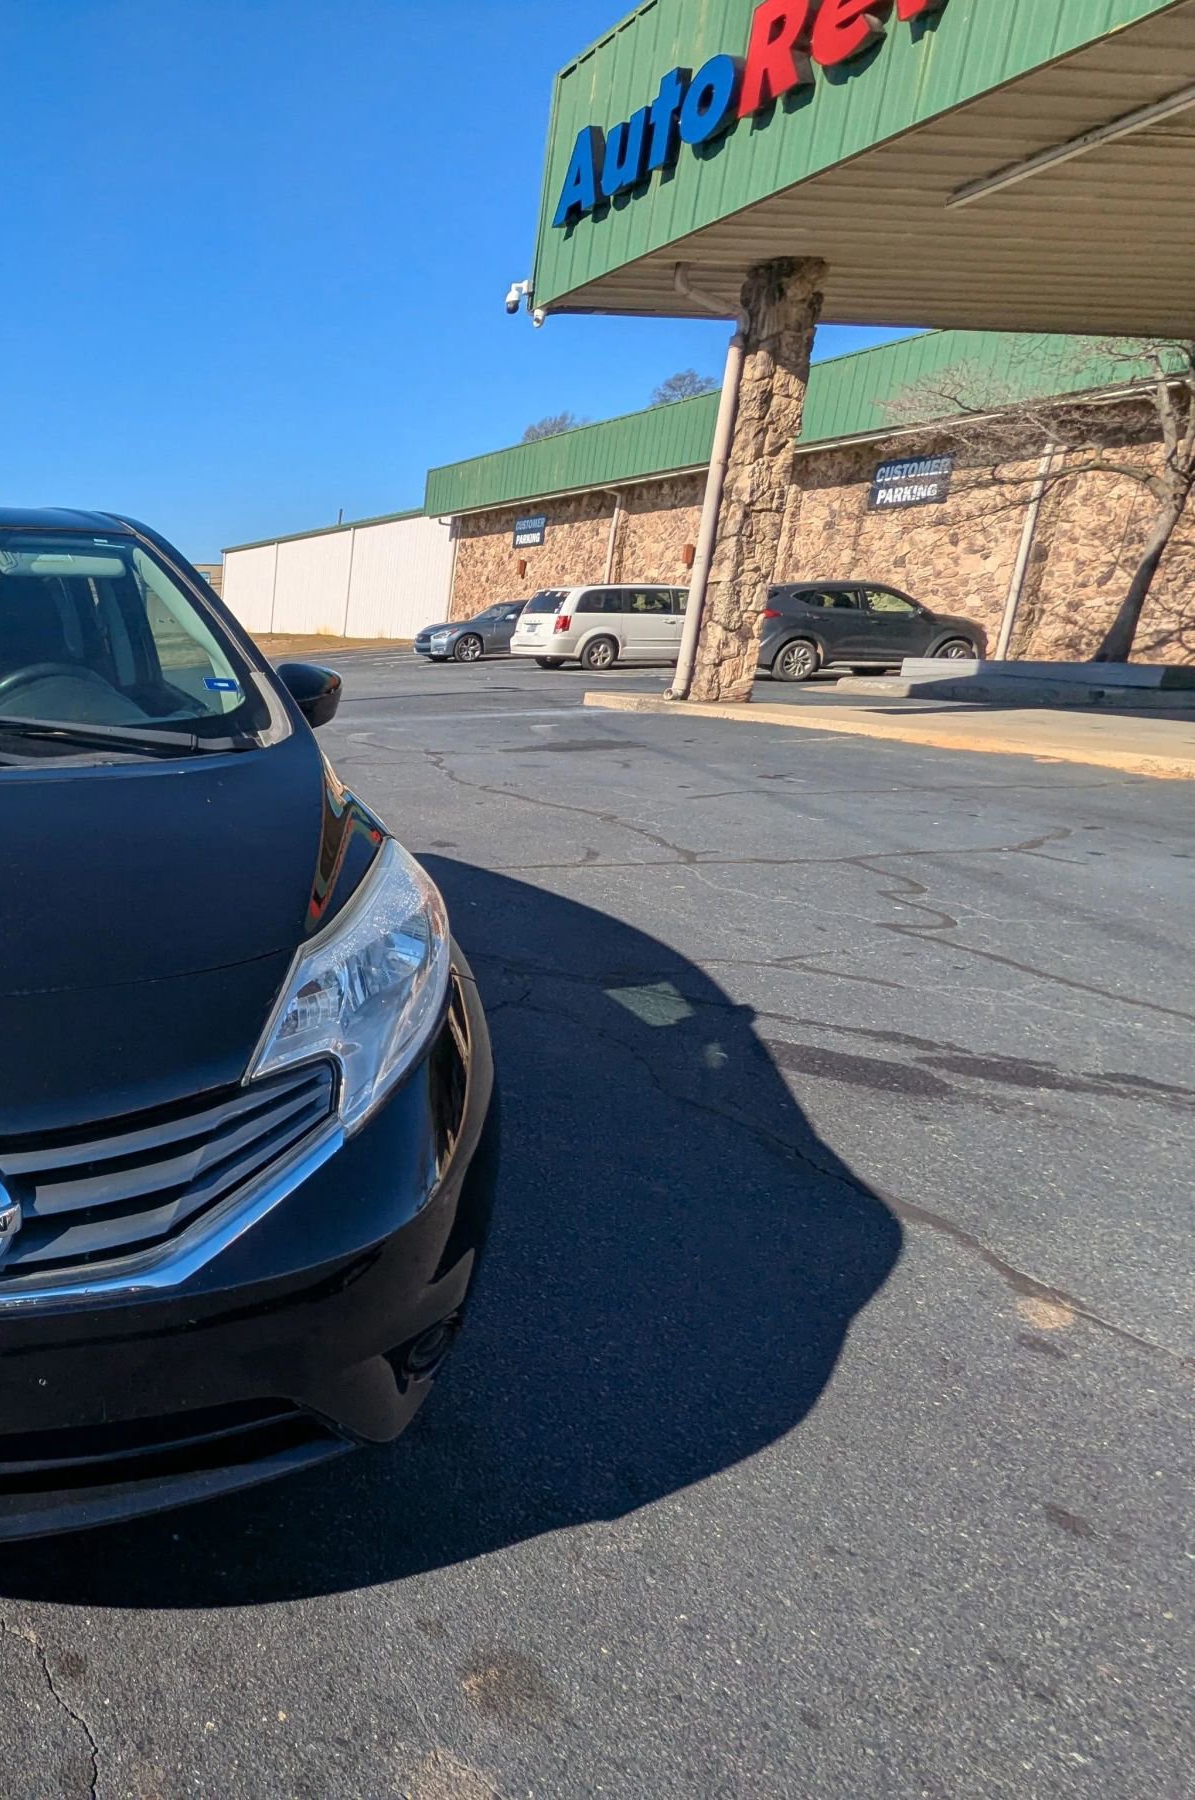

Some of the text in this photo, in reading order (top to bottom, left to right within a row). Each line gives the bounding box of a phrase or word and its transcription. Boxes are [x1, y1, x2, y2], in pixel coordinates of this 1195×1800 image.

[552, 0, 930, 228] AutoRe
[876, 458, 951, 482] CUSTOMER
[876, 484, 938, 504] PARKING
[515, 517, 546, 531] CUSTOMER
[515, 532, 541, 545] PARKING
